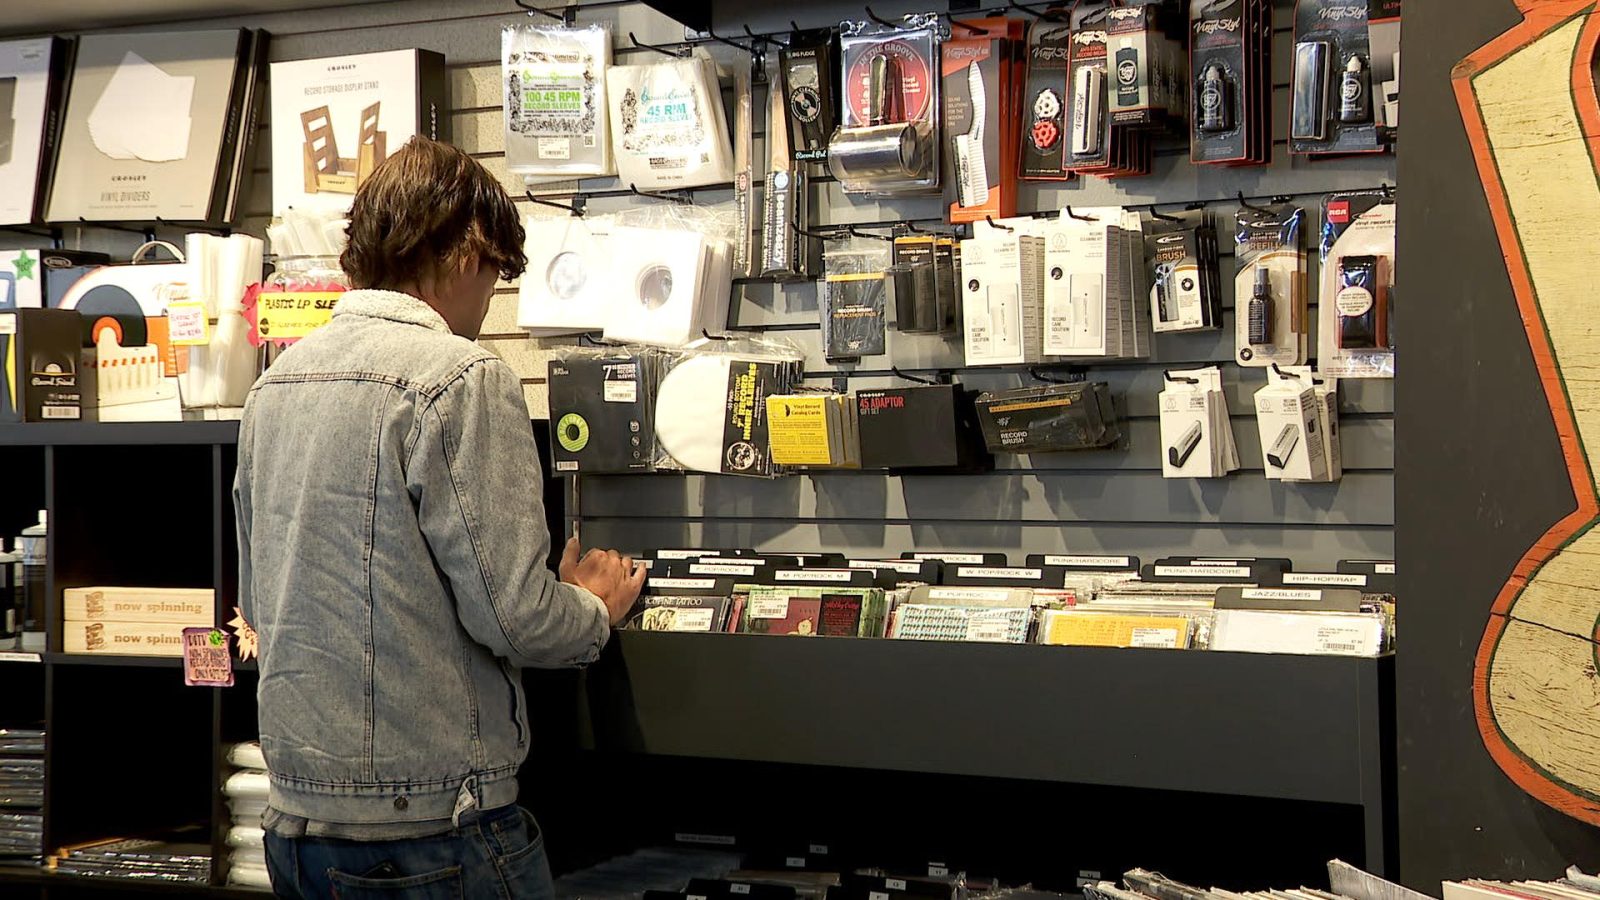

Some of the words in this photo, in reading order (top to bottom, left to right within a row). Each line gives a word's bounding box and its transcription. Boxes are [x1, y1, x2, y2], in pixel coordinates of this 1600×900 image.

[884, 43, 917, 61] GROOVE
[304, 86, 322, 96] RECORD
[323, 84, 344, 94] STORAGE
[344, 82, 364, 93] DISPLAY
[364, 80, 380, 90] STAND
[524, 92, 541, 102] 100
[544, 92, 556, 102] 45
[558, 92, 580, 102] RPM
[646, 106, 660, 116] 45
[796, 152, 815, 160] Record
[816, 150, 827, 158] Pal
[100, 192, 119, 202] VINYL
[120, 191, 151, 202] DIVIDERS
[1156, 250, 1186, 262] BRUSH
[264, 298, 294, 310] PLASTIC
[296, 300, 311, 310] LP
[314, 299, 338, 310] SLE
[746, 362, 757, 406] SLEEVES
[739, 374, 748, 416] RECORD
[860, 398, 869, 408] 45
[870, 397, 904, 409] ADAPTOR
[743, 409, 752, 440] INNER
[114, 602, 141, 611] now
[147, 602, 202, 614] spinning
[676, 598, 702, 606] TATTOO
[114, 635, 141, 643] now
